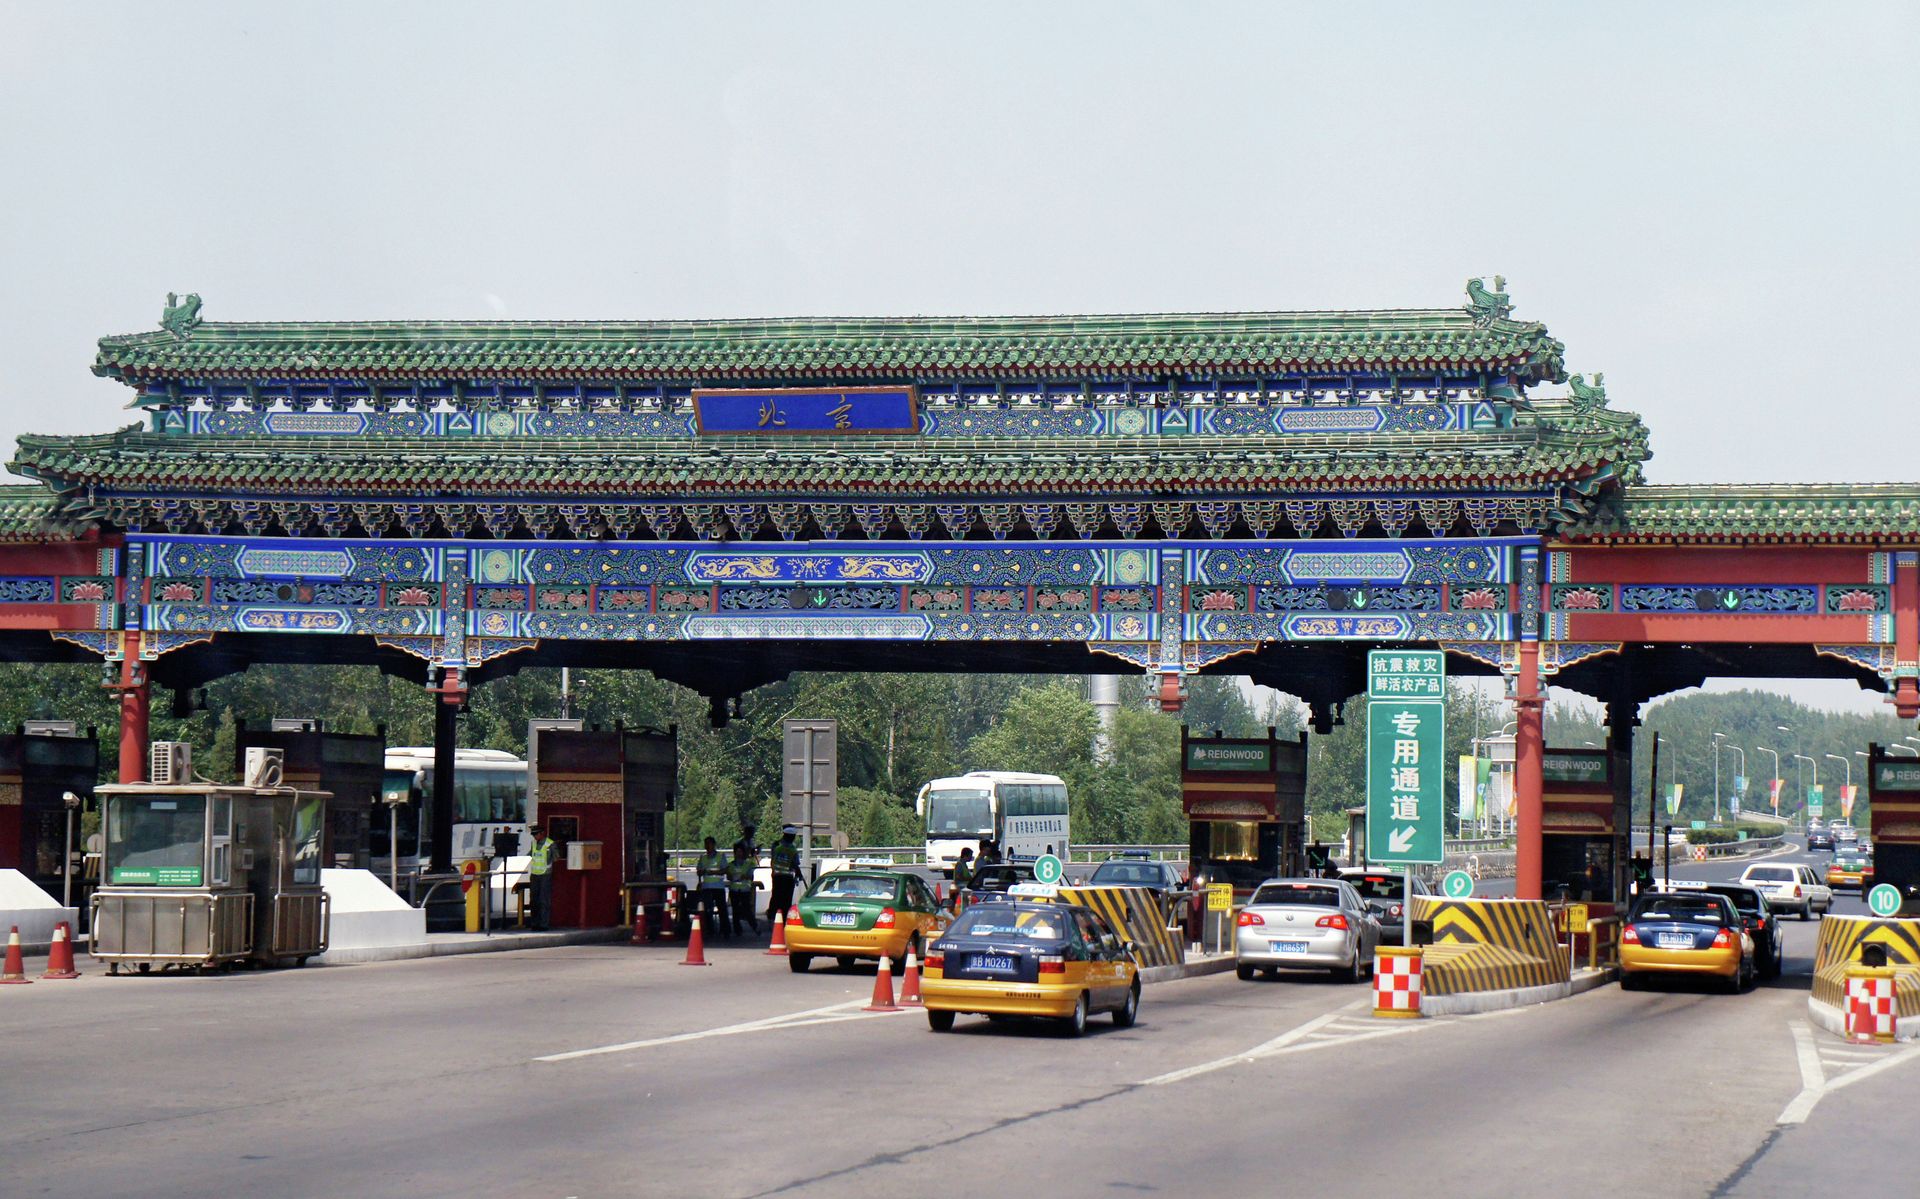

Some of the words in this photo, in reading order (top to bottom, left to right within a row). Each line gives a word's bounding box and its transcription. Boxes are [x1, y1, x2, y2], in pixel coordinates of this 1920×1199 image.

[757, 393, 853, 430] 北京
[1373, 657, 1438, 673] 抗震救灾
[1375, 676, 1440, 693] 鲜活农产品
[1207, 749, 1265, 760] REIGNWOOD
[1390, 710, 1421, 821] 专用通道
[1543, 759, 1601, 771] REIGNWOOD
[1042, 861, 1054, 879] 8
[1452, 878, 1466, 895] 9
[1876, 890, 1894, 910] 10
